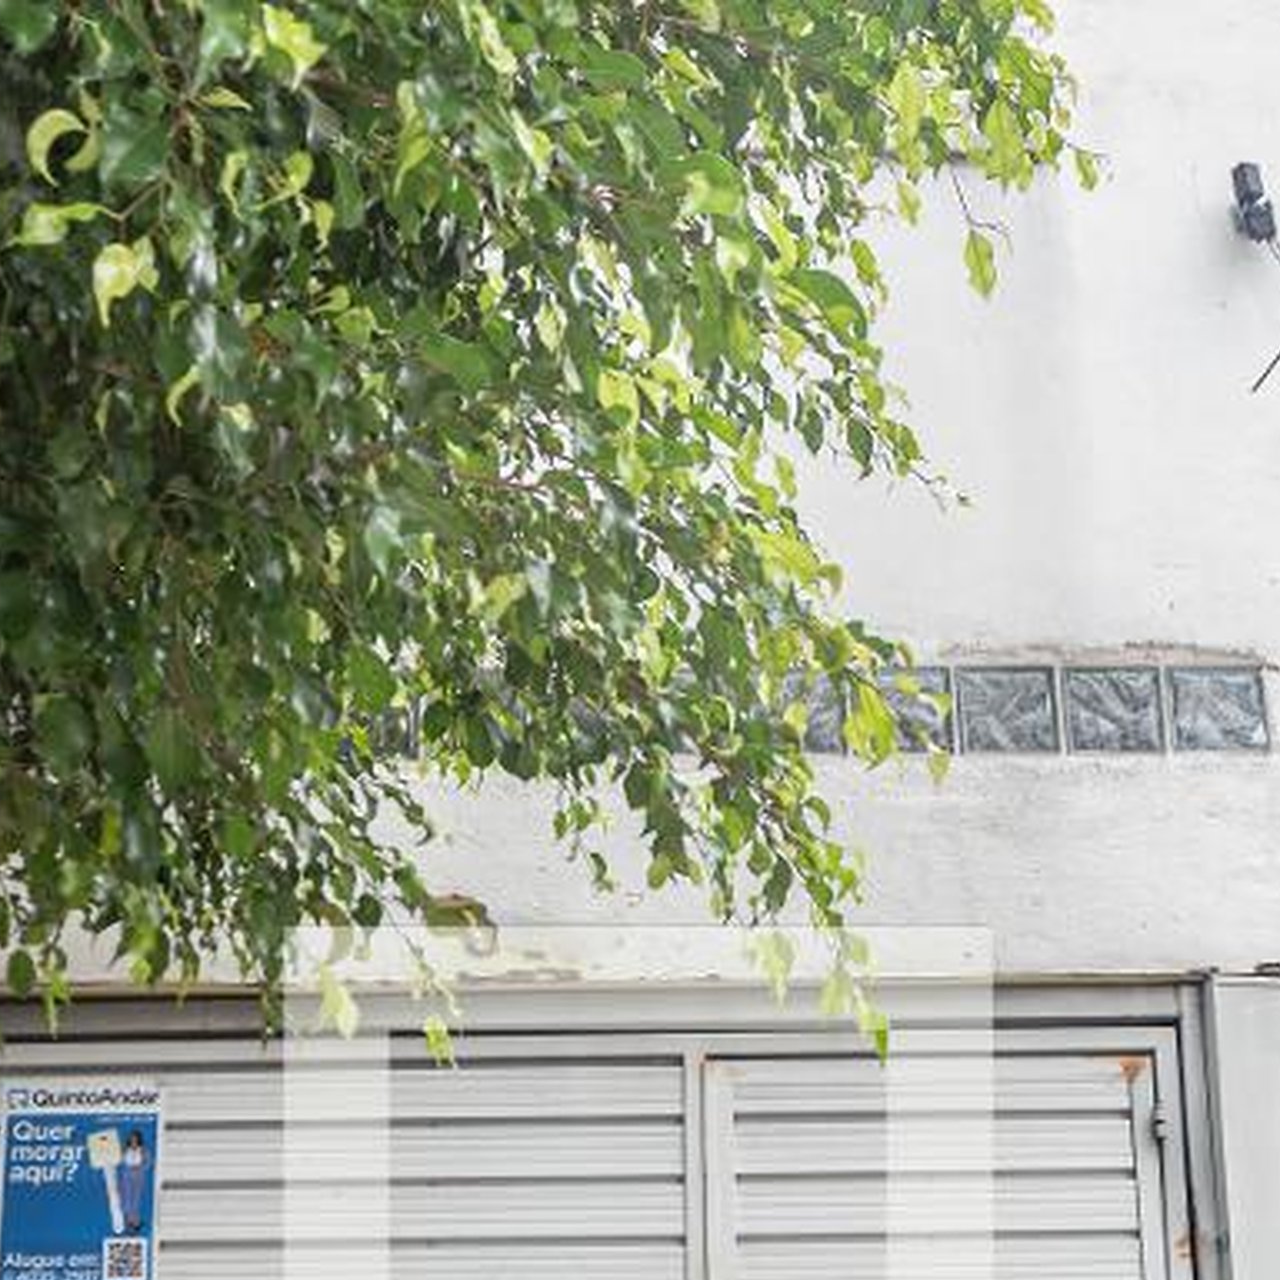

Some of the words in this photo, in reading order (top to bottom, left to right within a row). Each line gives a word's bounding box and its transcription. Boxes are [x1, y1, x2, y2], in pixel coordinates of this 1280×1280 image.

[33, 1087, 159, 1107] QuintoAndar
[13, 1119, 76, 1142] Quer
[10, 1144, 85, 1161] morar
[9, 1162, 79, 1186] aqui?
